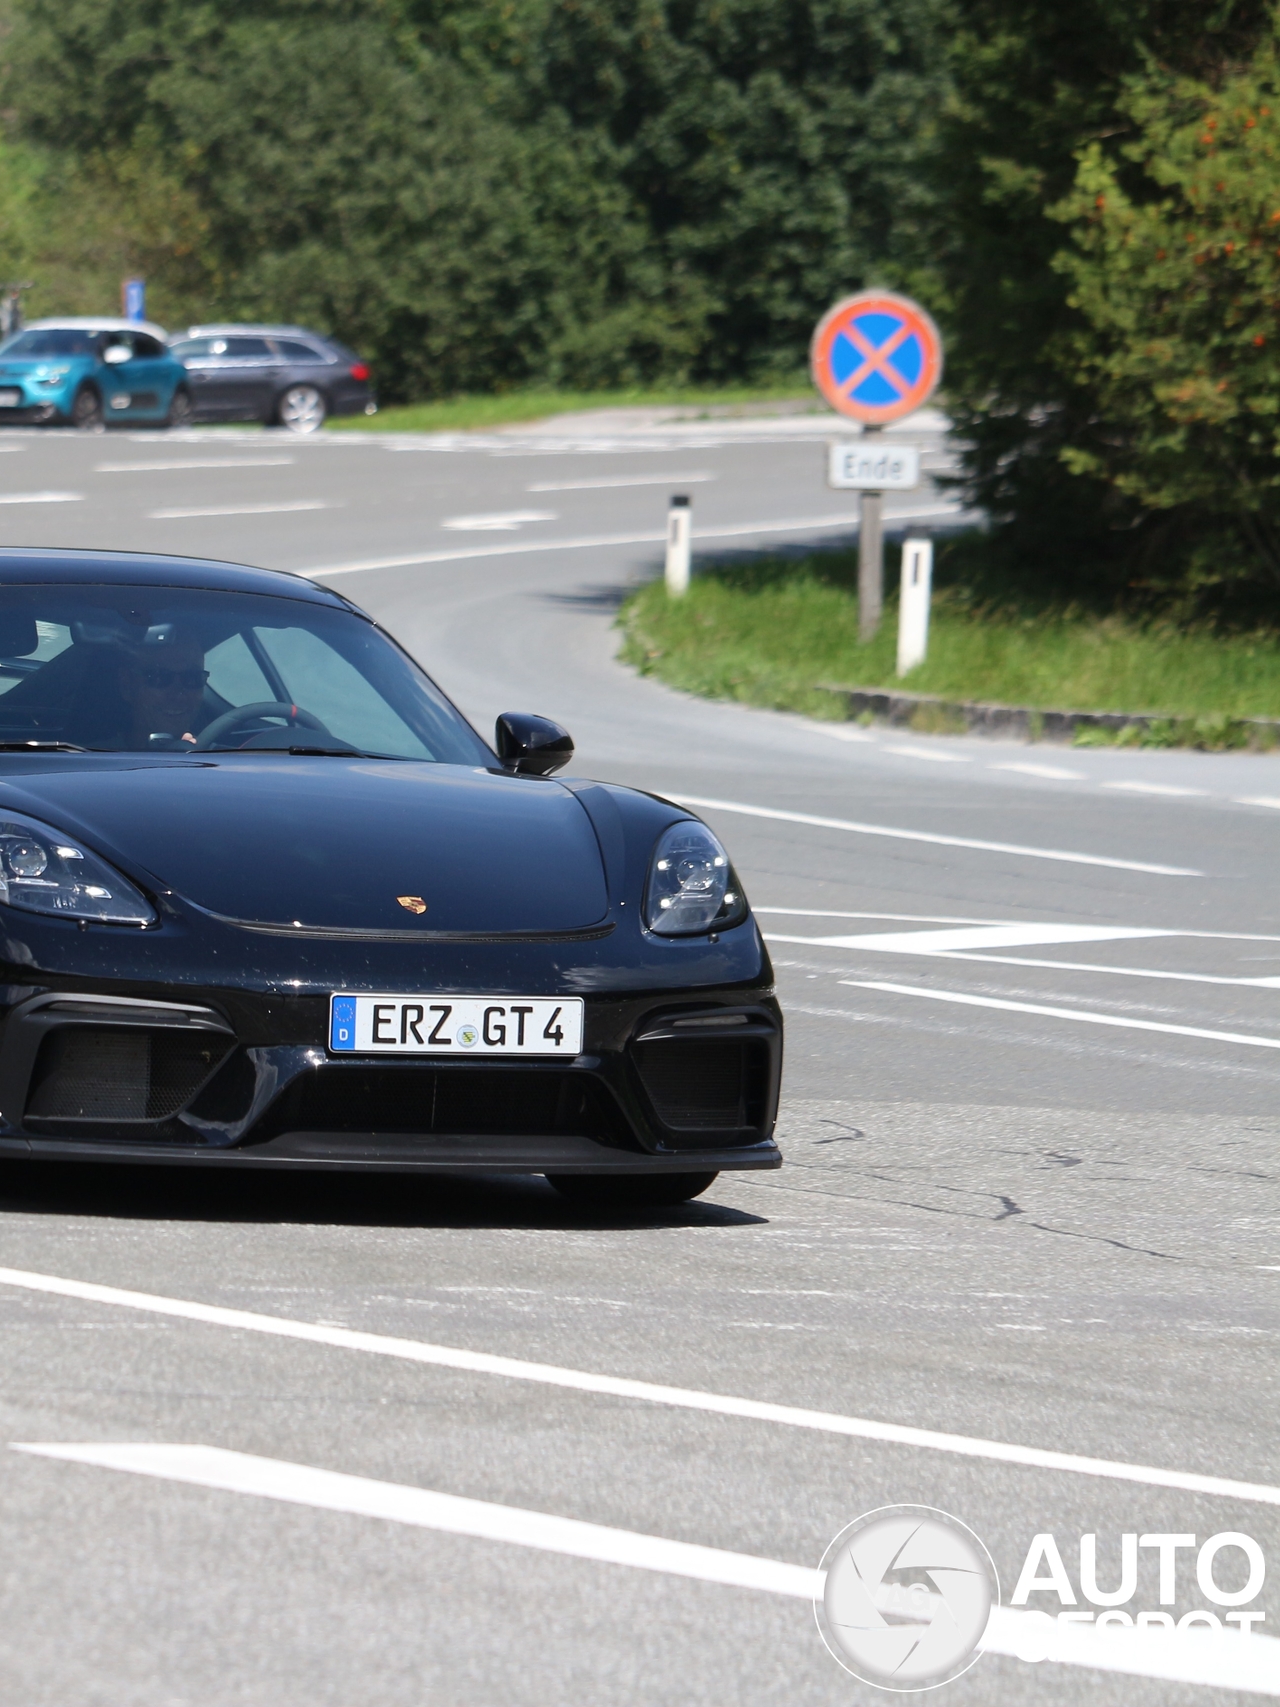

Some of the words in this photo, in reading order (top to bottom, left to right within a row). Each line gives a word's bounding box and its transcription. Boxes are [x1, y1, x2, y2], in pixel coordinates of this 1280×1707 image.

[843, 453, 903, 480] Ende
[338, 1028, 349, 1042] D
[372, 1004, 453, 1045] ERZ
[482, 1006, 534, 1046] GT
[543, 1006, 564, 1046] 4
